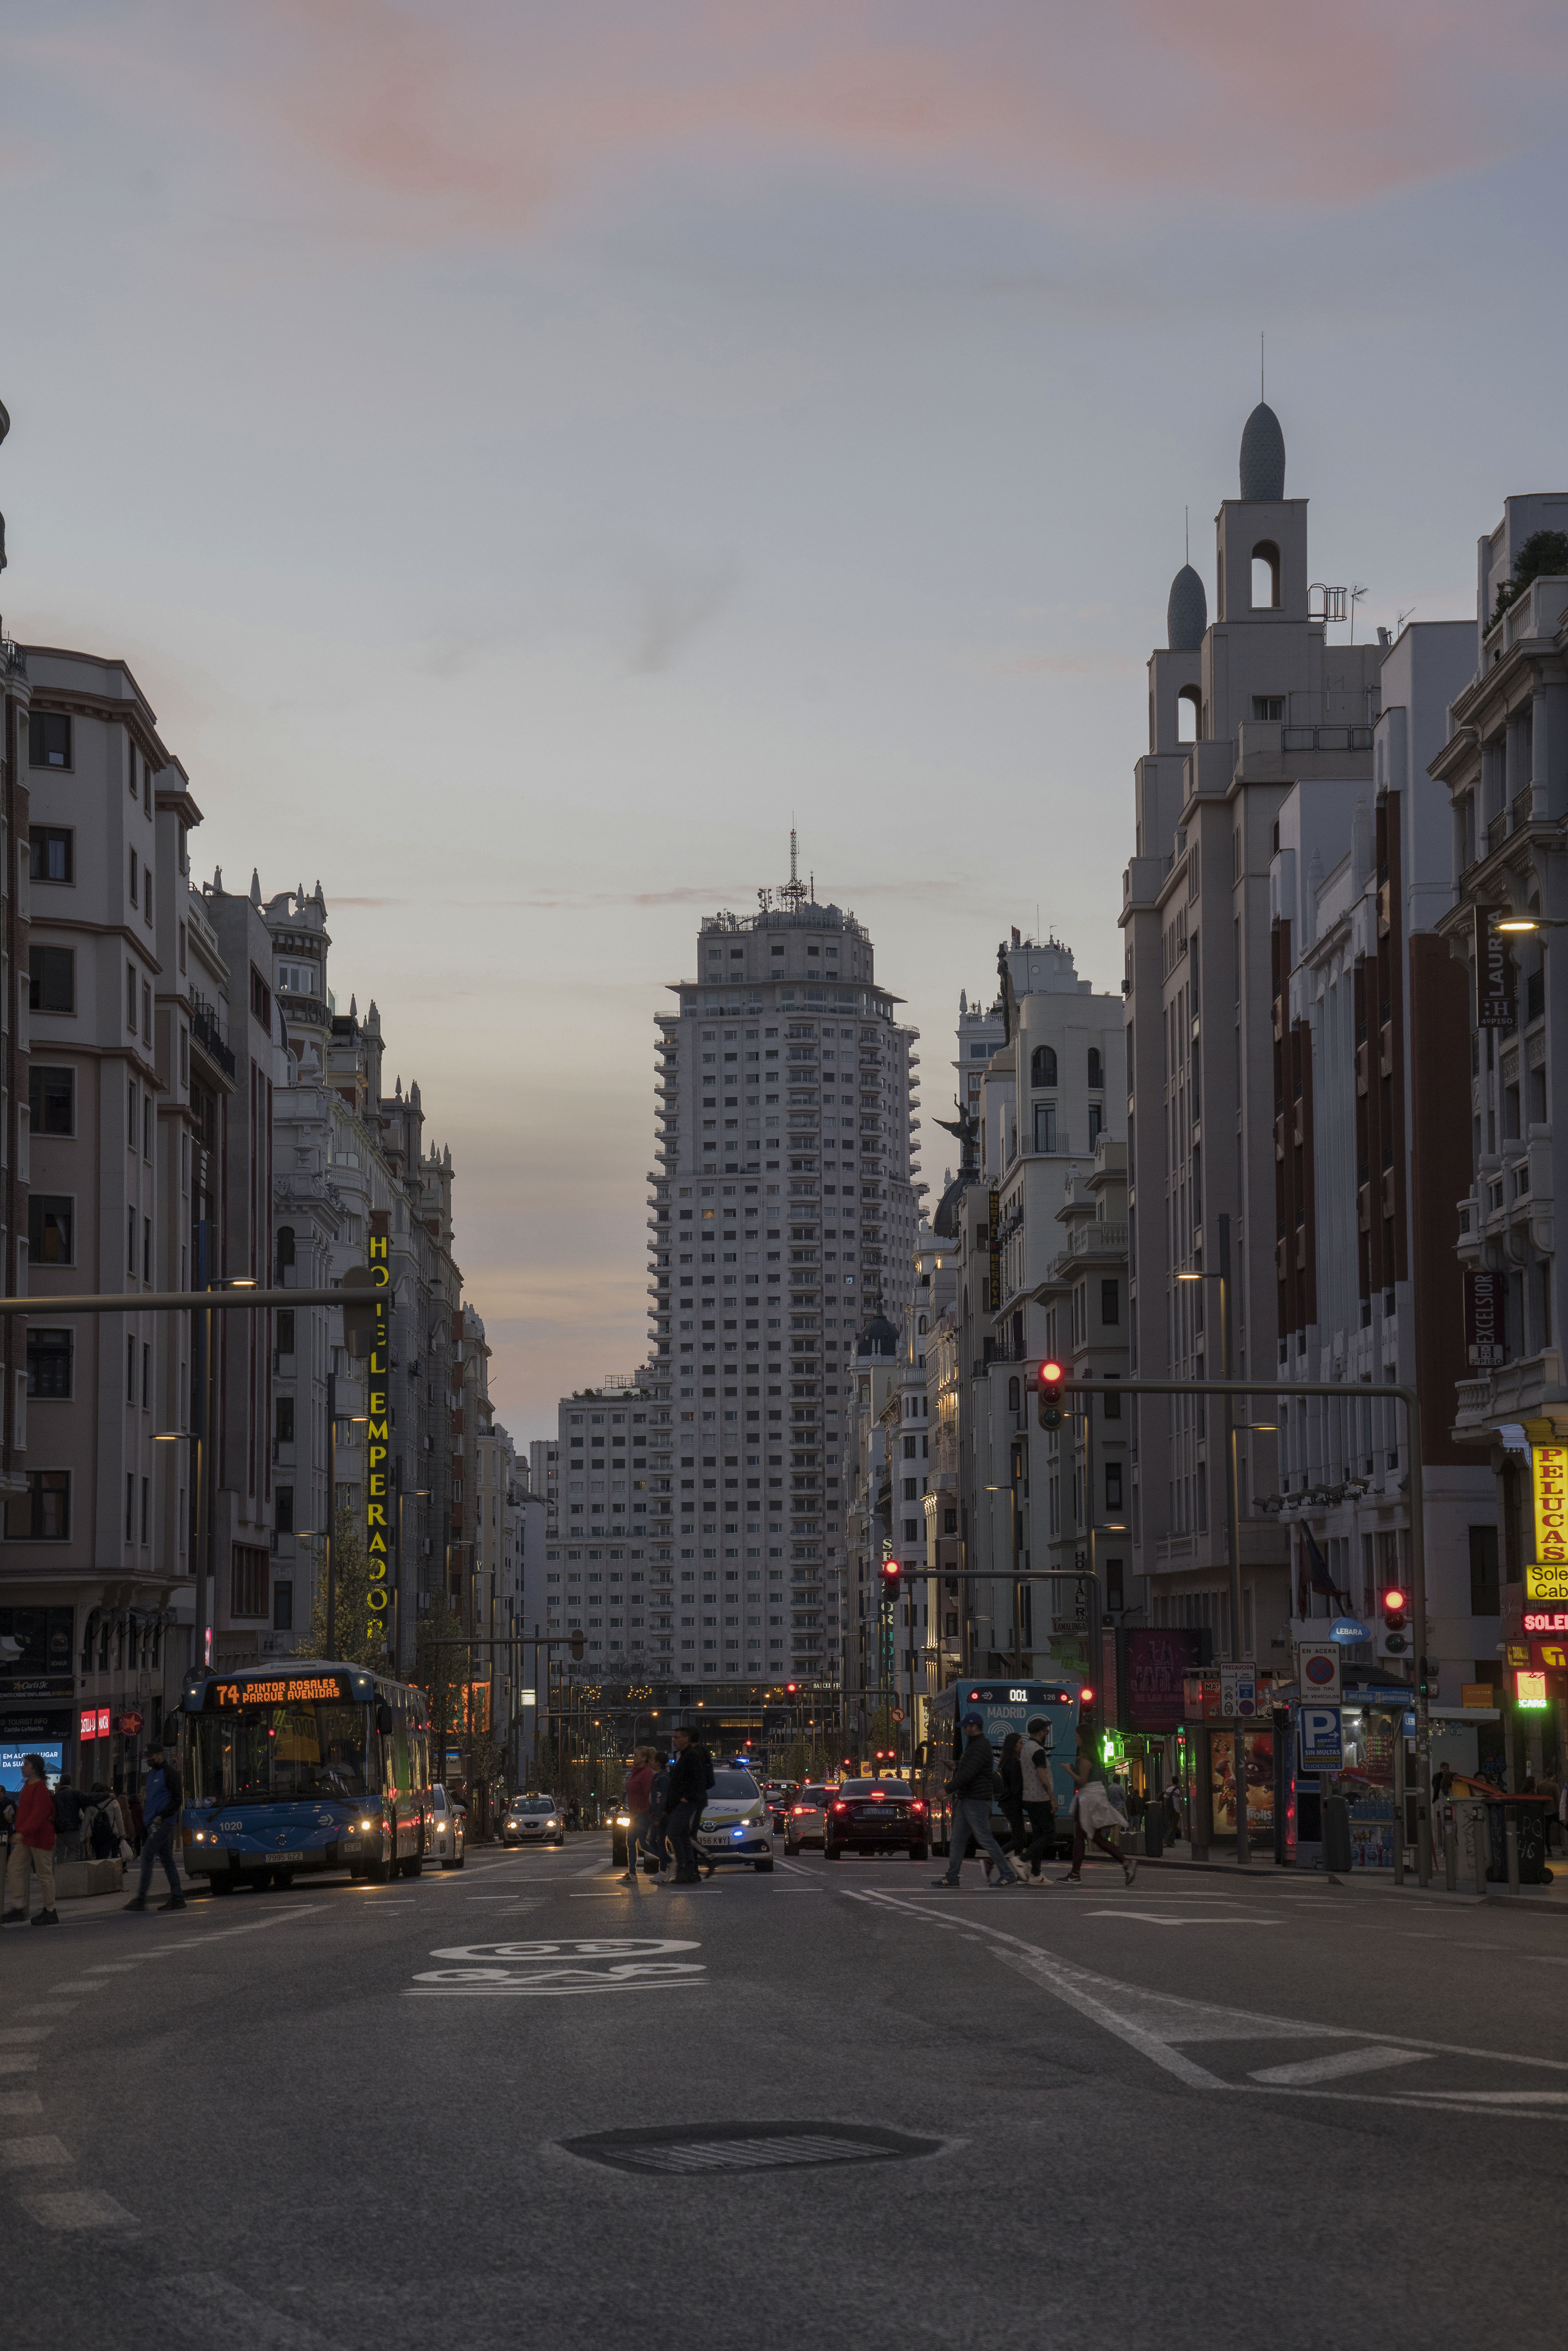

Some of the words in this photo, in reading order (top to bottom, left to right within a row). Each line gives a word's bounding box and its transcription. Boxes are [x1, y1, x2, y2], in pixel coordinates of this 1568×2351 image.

[1474, 1274, 1494, 1344] EXCELSIOR
[1538, 1449, 1567, 1560] PELUCAS
[367, 1393, 389, 1640] EMPERADOR
[1525, 1614, 1568, 1630] SOLE
[1149, 1641, 1174, 1665] LA
[247, 1682, 286, 1693] PINTOR
[289, 1678, 336, 1691] ROSALES
[216, 1685, 239, 1705] 74
[243, 1691, 284, 1703] PARQUE
[287, 1687, 340, 1700] AVENIDAS
[1010, 1689, 1028, 1702] 001
[987, 1707, 1026, 1719] MADRID
[1305, 1710, 1336, 1748] P
[219, 1821, 243, 1831] 1020
